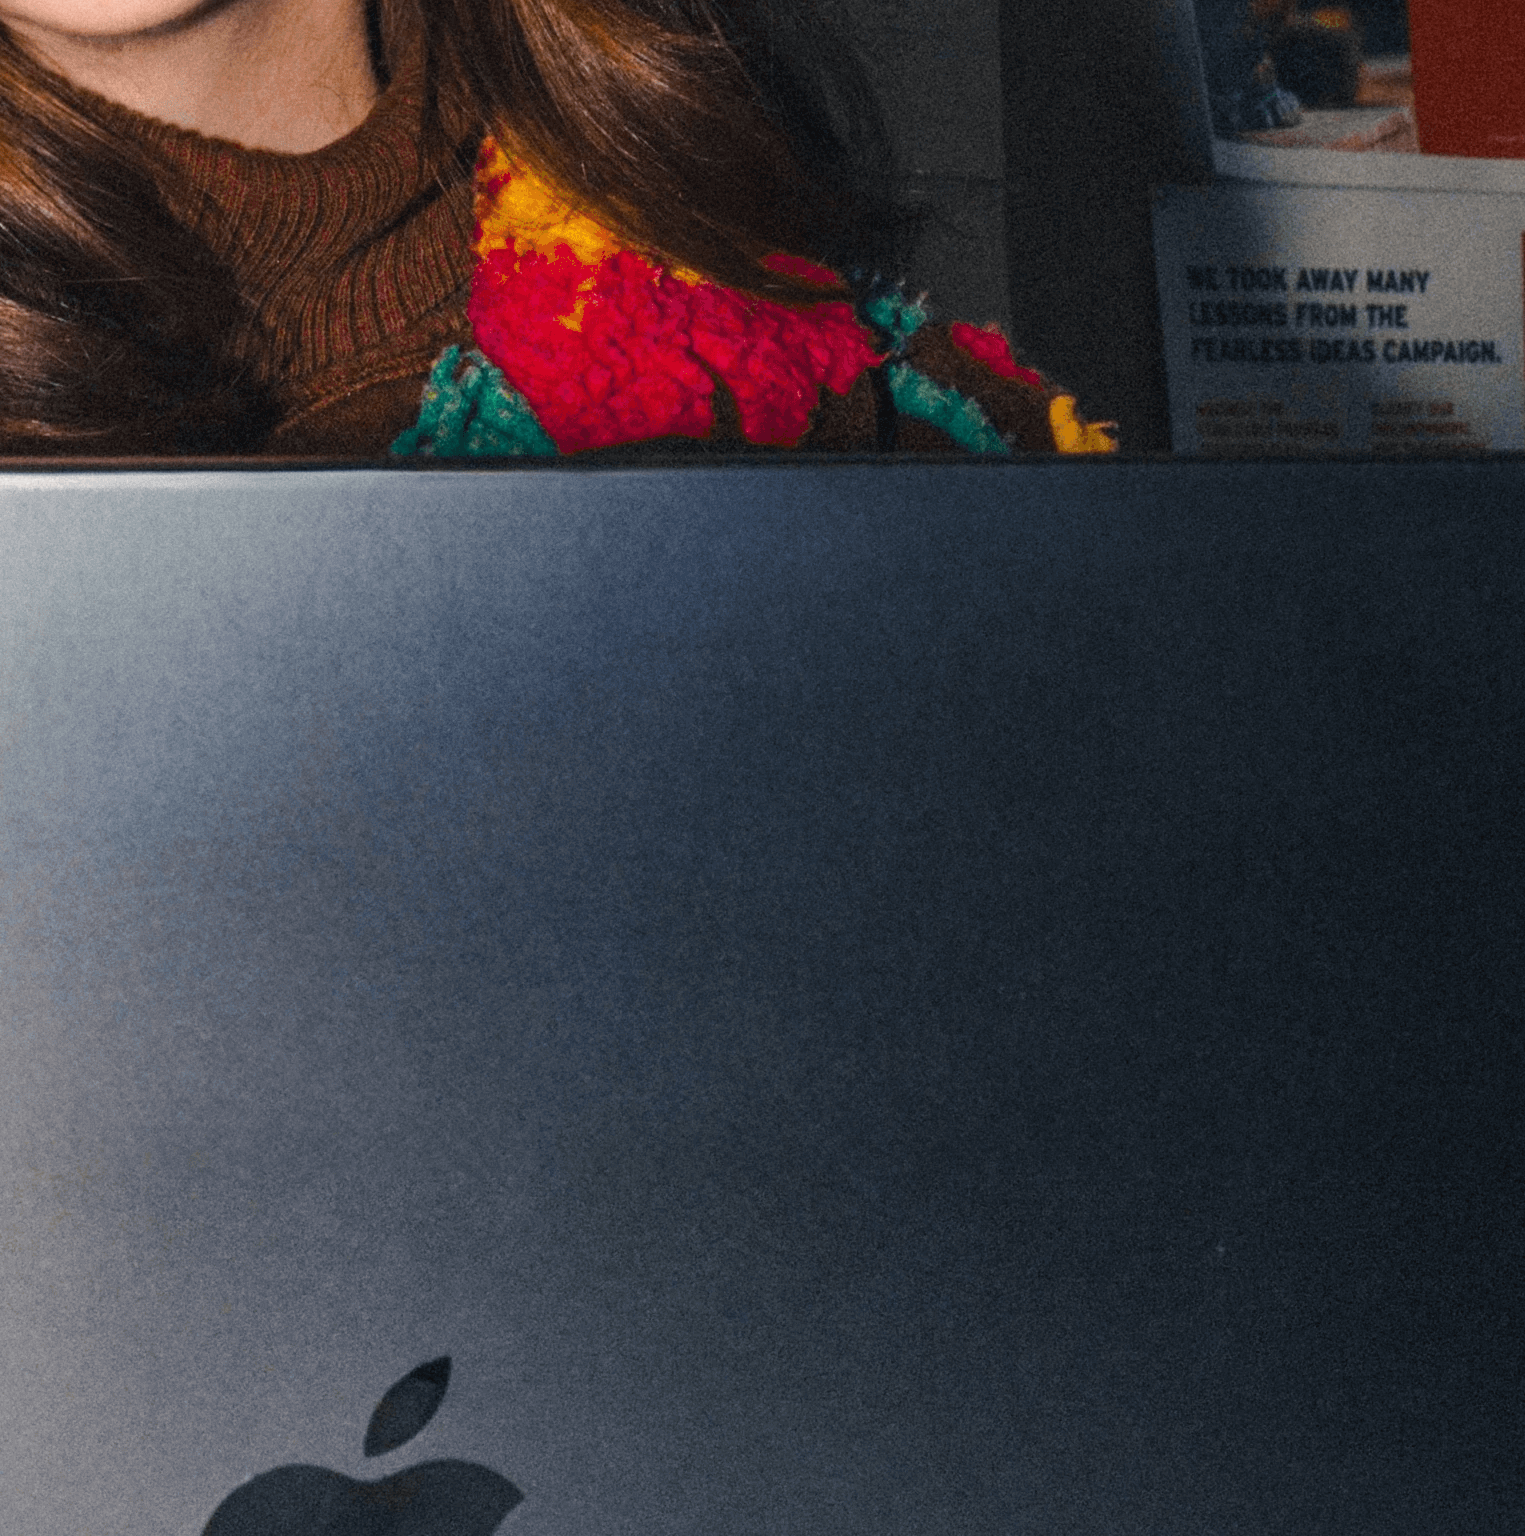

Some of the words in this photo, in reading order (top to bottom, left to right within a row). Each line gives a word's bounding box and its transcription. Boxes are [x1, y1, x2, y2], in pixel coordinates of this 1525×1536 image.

[1186, 266, 1219, 291] WE
[1225, 266, 1288, 292] TOOK
[1296, 267, 1359, 294] AWAY
[1366, 268, 1430, 294] MANY
[1189, 300, 1288, 327] LESSONS
[1295, 302, 1358, 327] FROM
[1366, 302, 1410, 329] THE
[1191, 337, 1303, 363] FEARLESS
[1309, 338, 1375, 364] IDEAS
[1381, 339, 1503, 364] CAMPAIGN.
